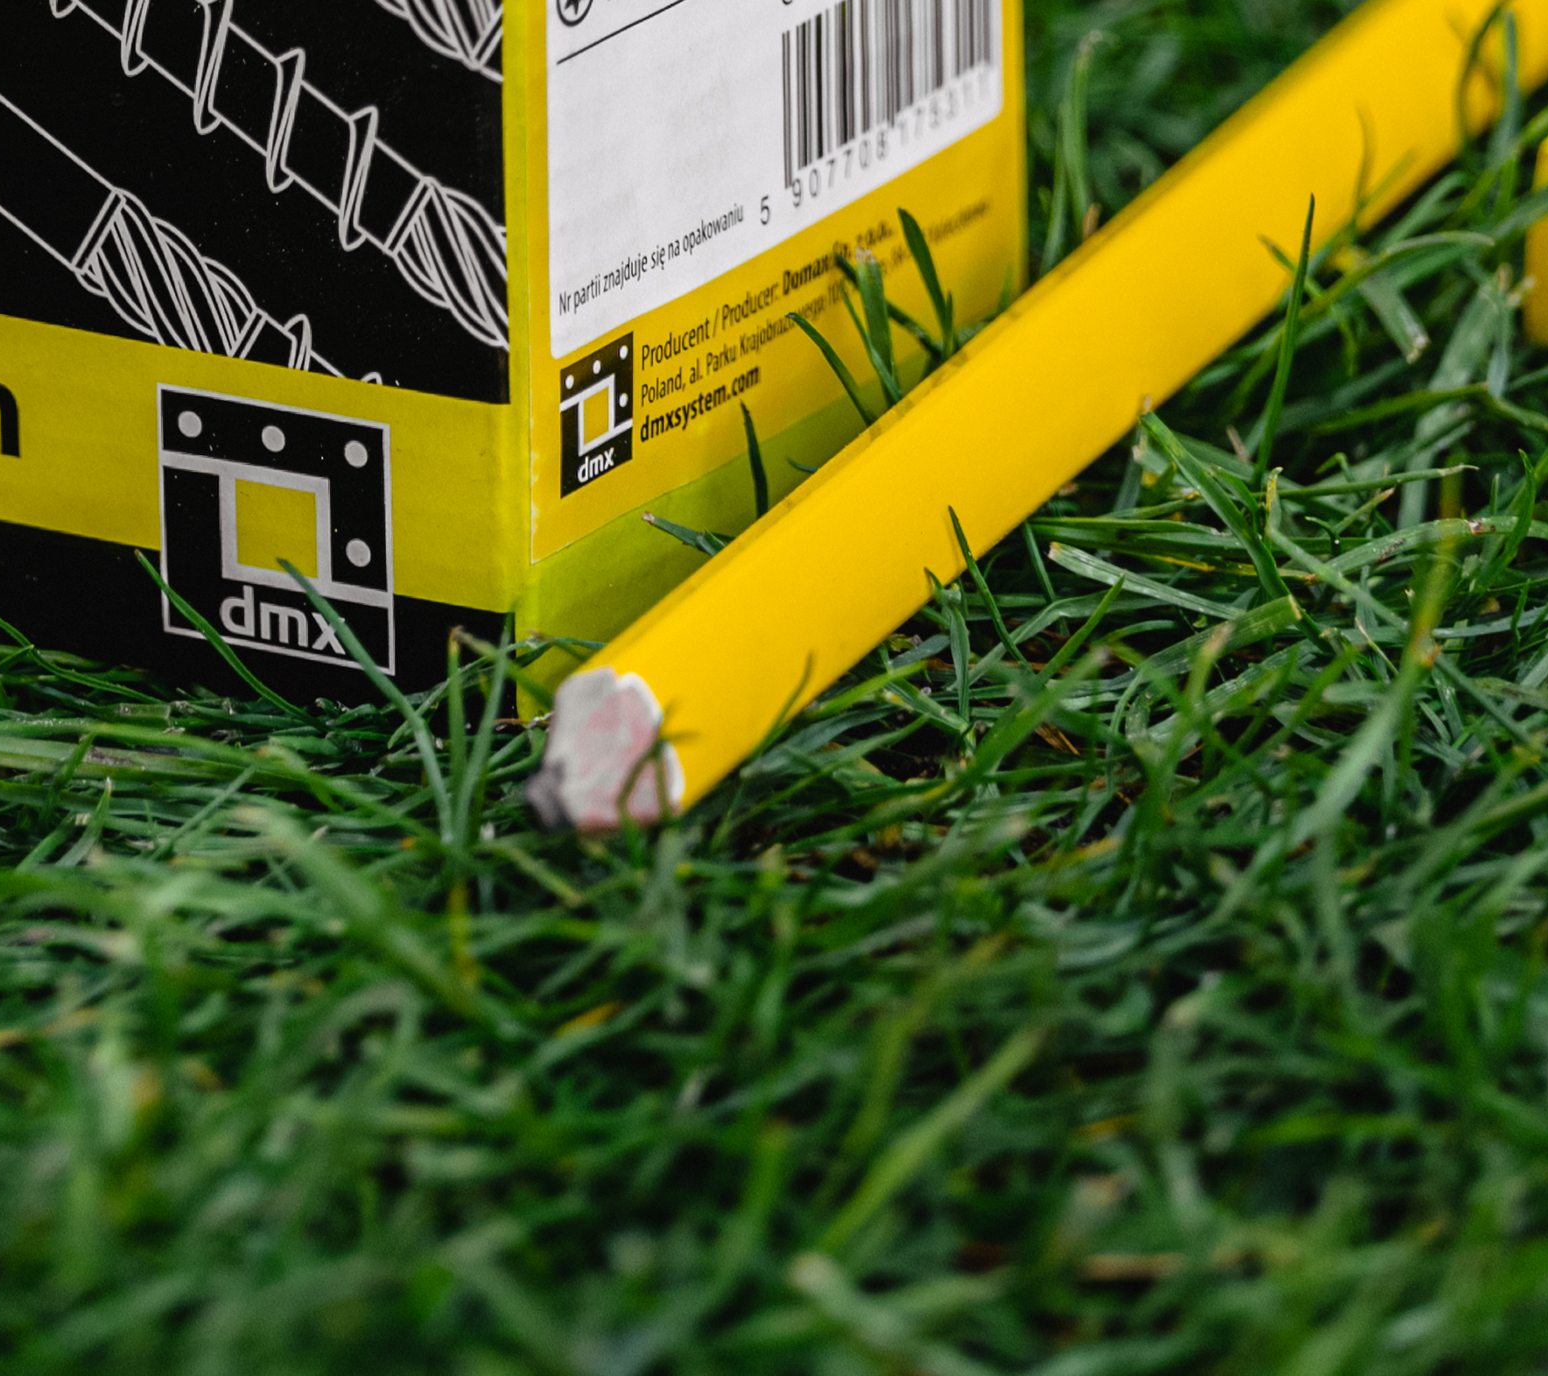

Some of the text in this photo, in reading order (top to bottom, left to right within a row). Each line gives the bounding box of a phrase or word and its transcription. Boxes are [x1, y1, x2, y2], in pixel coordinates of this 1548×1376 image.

[760, 194, 771, 226] 5
[559, 203, 744, 316] Nr partii znajduje się na opakowaniu
[641, 317, 711, 371] Producent
[712, 308, 719, 338] /
[722, 281, 780, 331] Producer:
[782, 254, 829, 296] Domax
[640, 366, 760, 443] dmxsystem.com
[641, 366, 686, 408] Poland,
[689, 358, 703, 385] al.
[706, 343, 737, 376] Parku
[577, 448, 615, 484] dmx
[219, 584, 347, 656] dmx
